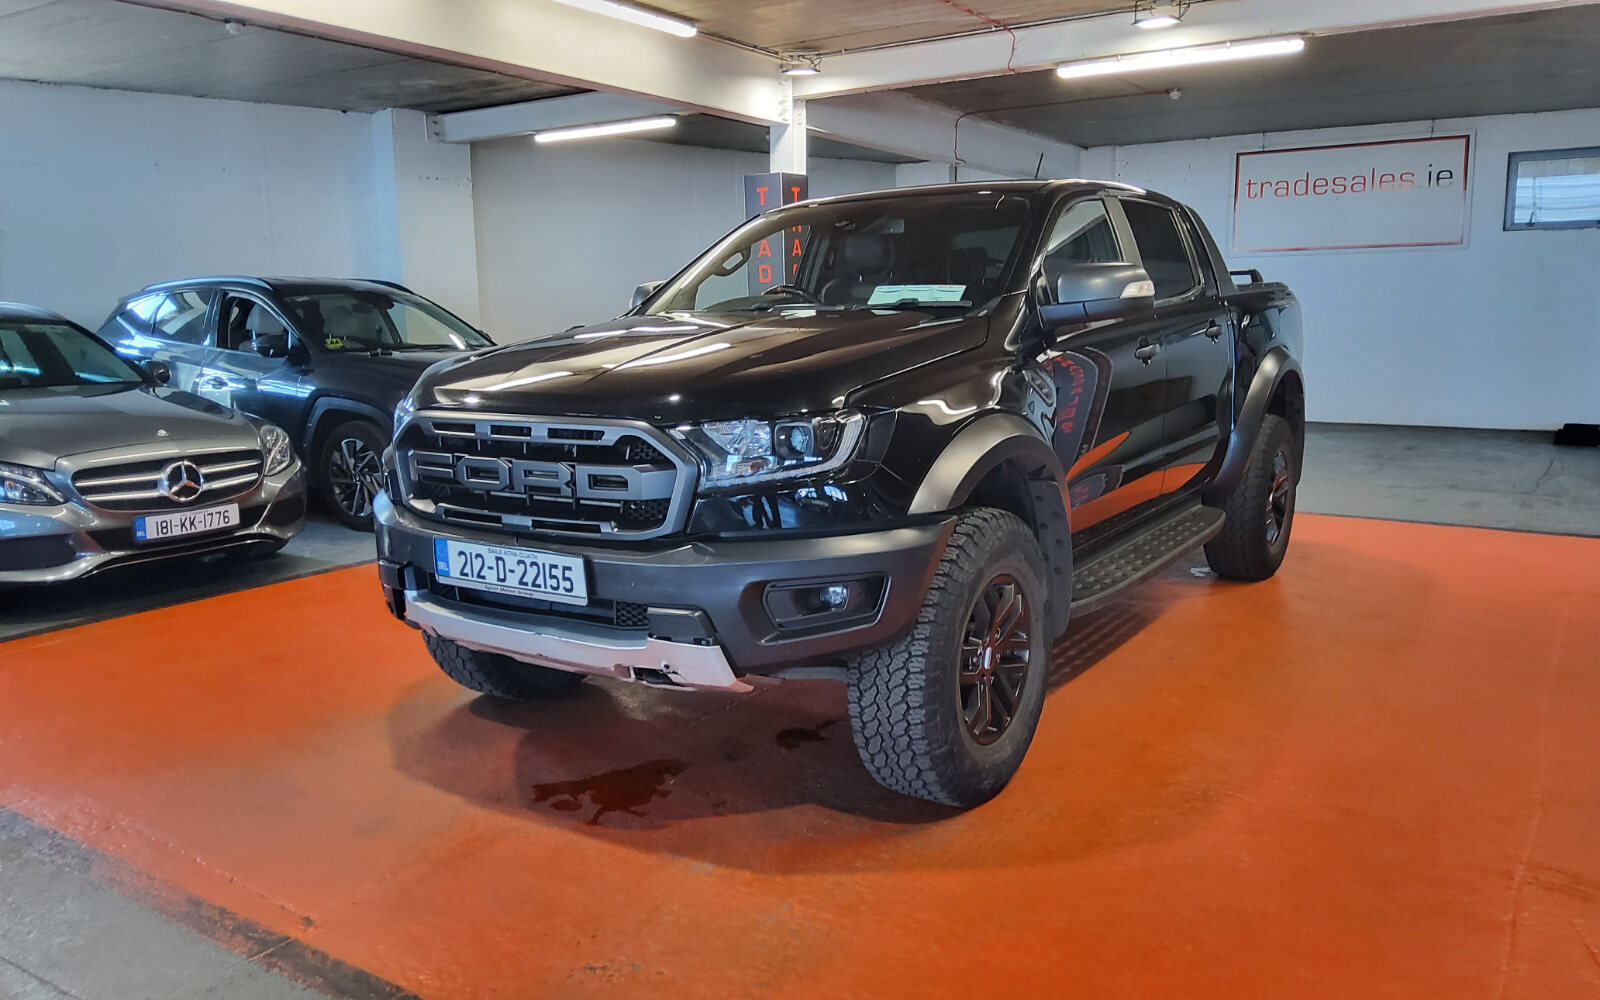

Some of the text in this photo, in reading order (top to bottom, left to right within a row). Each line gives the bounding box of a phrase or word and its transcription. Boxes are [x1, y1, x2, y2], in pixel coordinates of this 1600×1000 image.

[1245, 164, 1454, 200] tradesales.ie
[409, 451, 643, 500] FORD
[156, 510, 230, 536] 181-KK-1776
[458, 550, 574, 593] 212-D-22155
